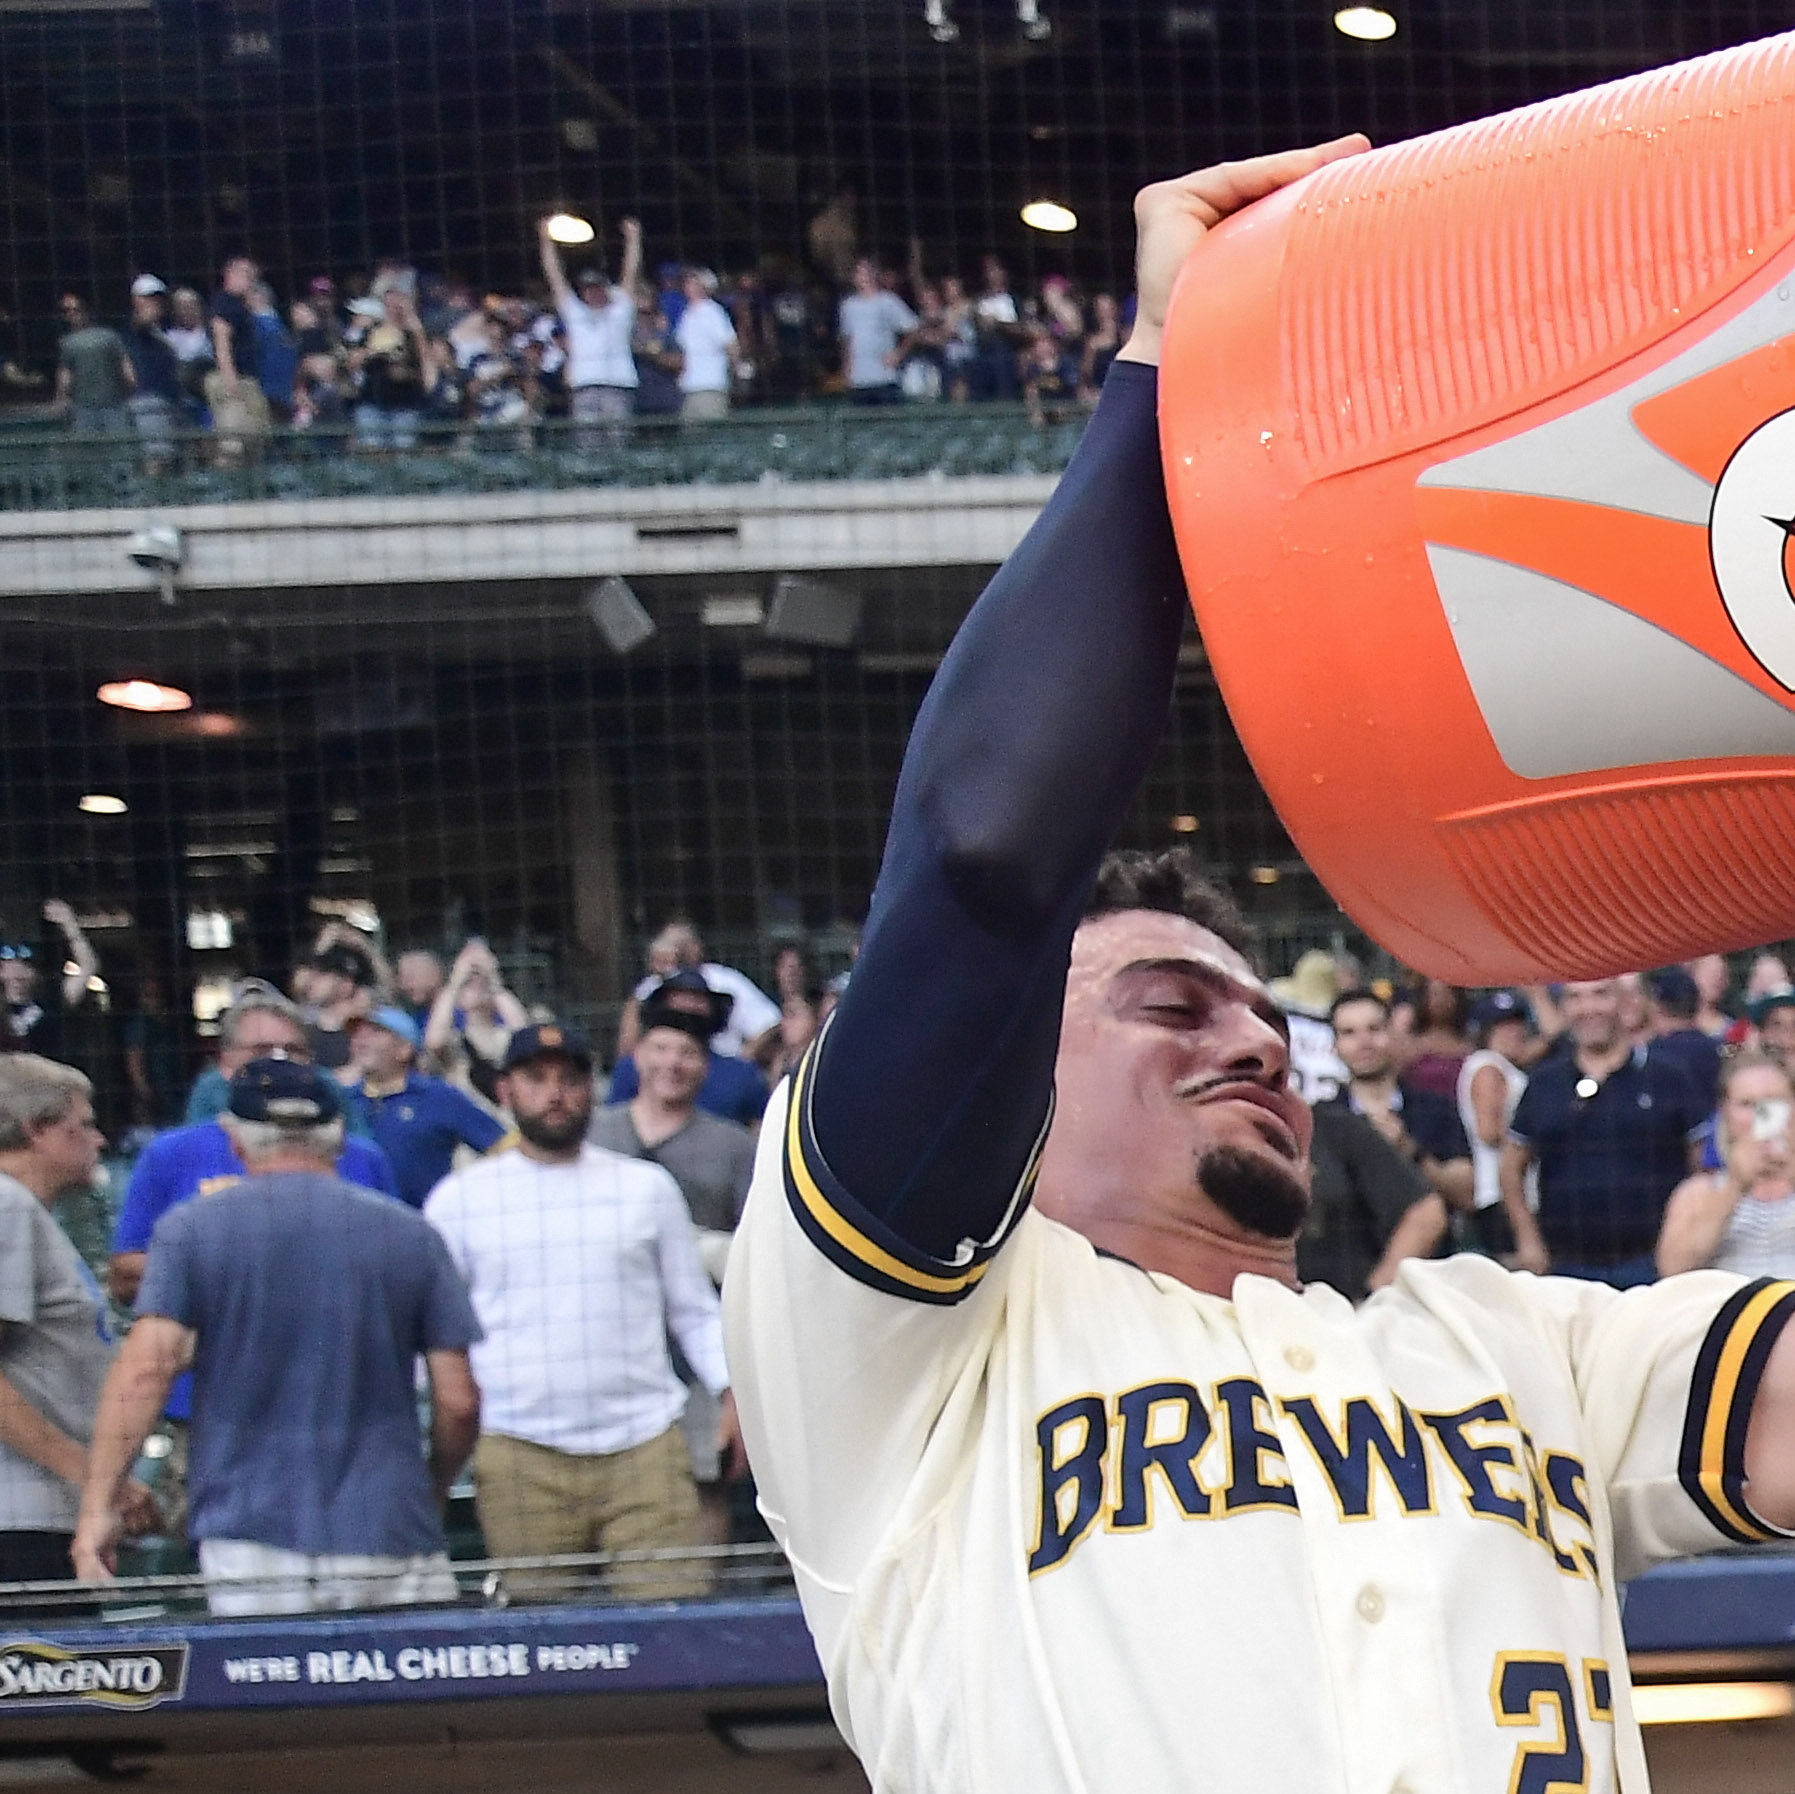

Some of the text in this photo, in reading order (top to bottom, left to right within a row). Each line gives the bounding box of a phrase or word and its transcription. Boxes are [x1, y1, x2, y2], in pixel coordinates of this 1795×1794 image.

[1029, 1376, 1602, 1594] BREWES
[0, 1654, 164, 1698] SARGENTO
[307, 1650, 396, 1684] REAL
[396, 1643, 531, 1680] CHEESE
